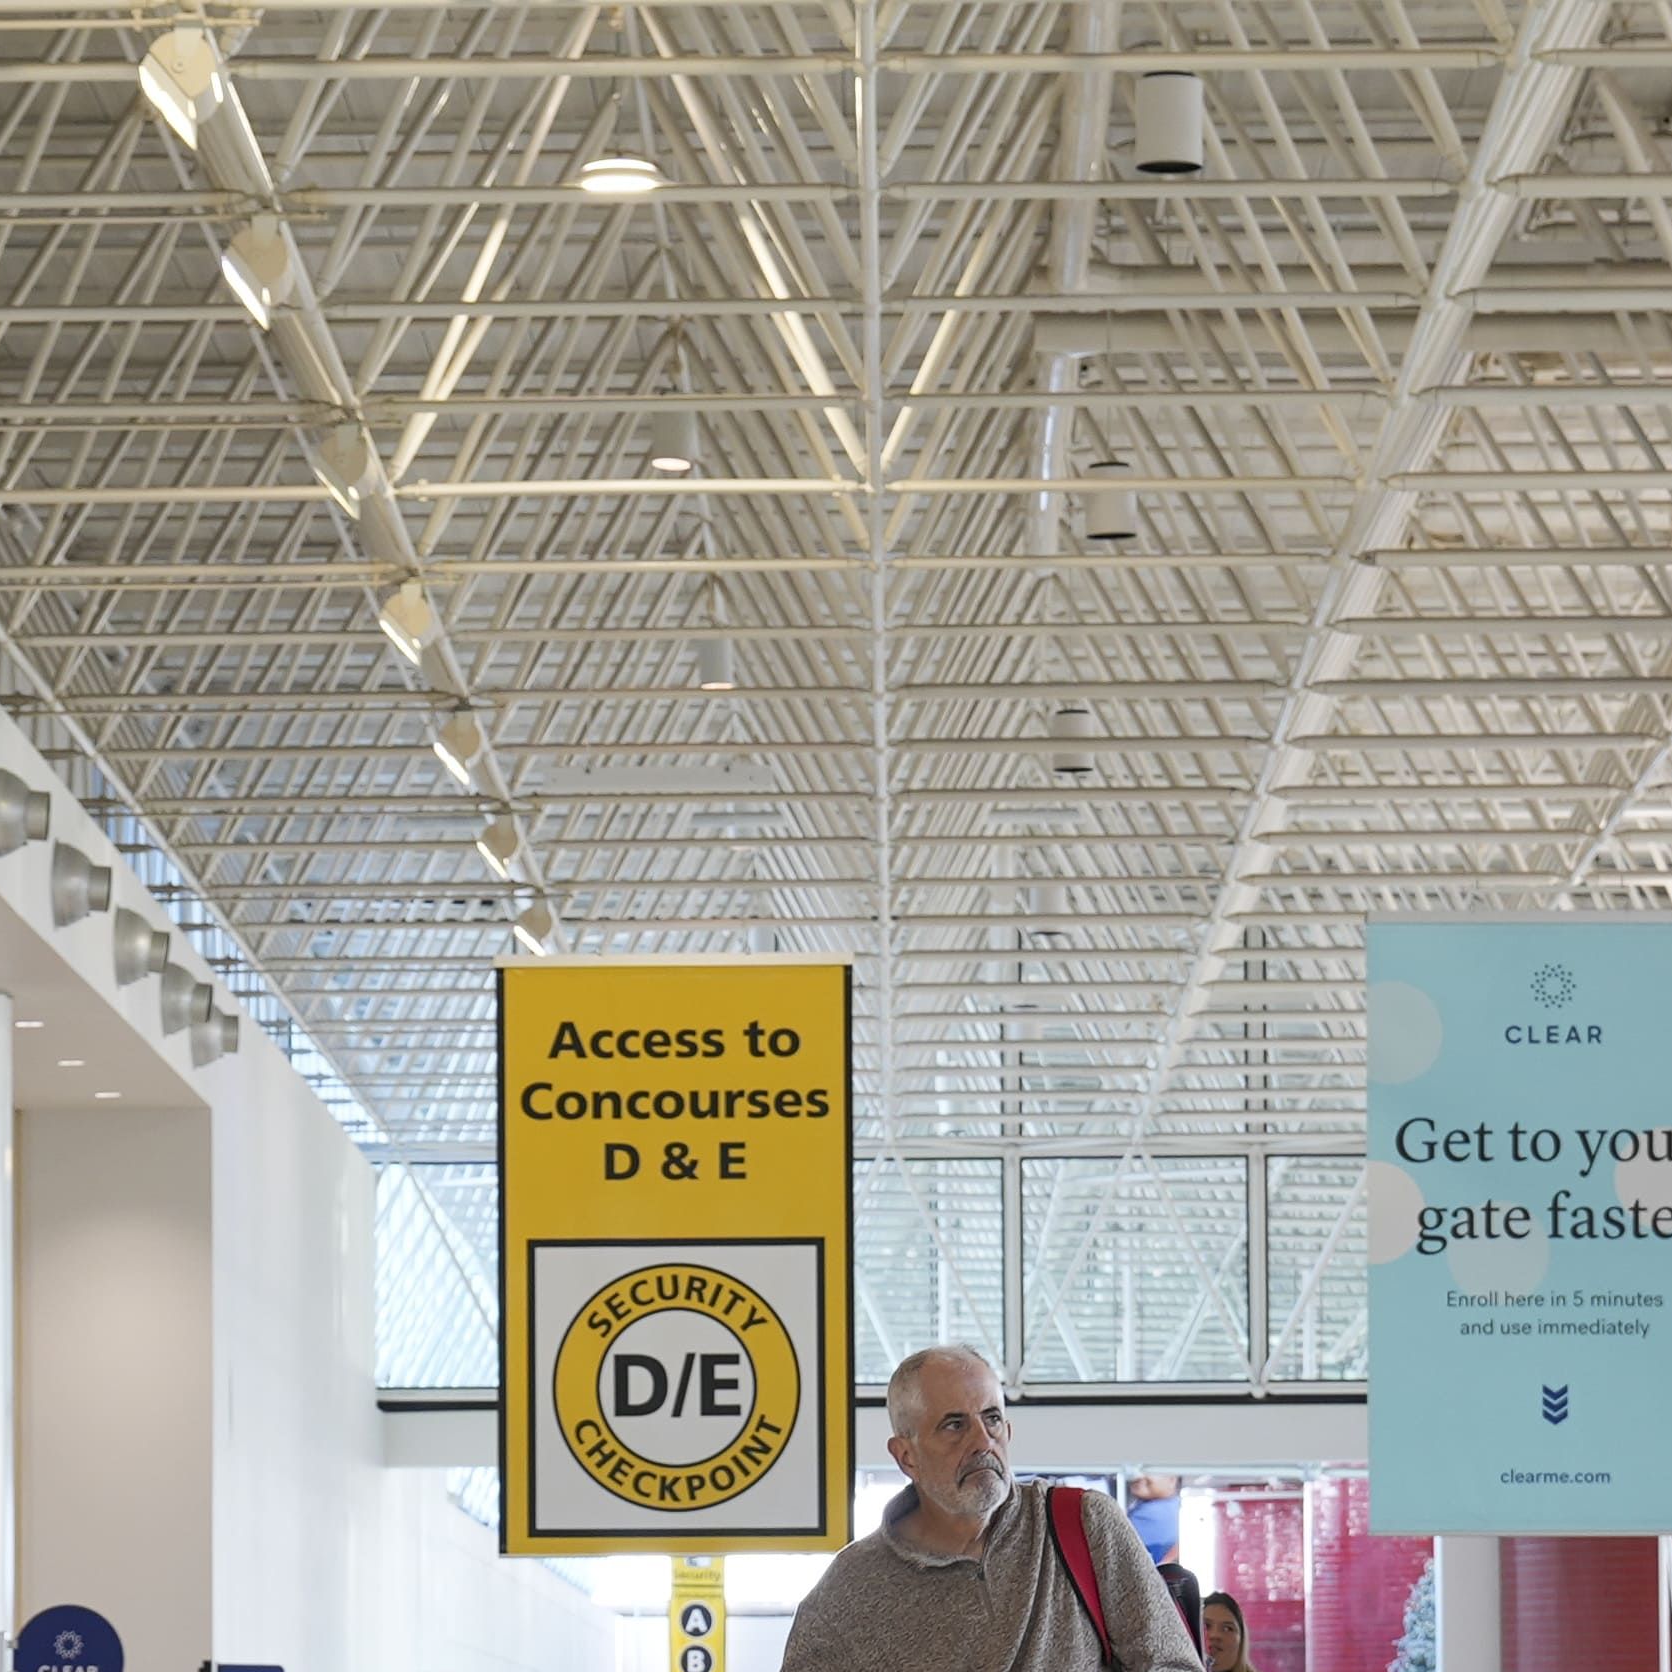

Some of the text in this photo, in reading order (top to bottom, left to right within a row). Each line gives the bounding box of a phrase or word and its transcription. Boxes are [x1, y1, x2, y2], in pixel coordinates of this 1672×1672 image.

[548, 1020, 800, 1059] Access to
[1504, 1024, 1604, 1045] CLEAR
[520, 1082, 830, 1120] Concourses
[1395, 1117, 1494, 1164] Get
[1510, 1120, 1561, 1164] to
[604, 1142, 748, 1180] D & E
[1415, 1198, 1531, 1256] gate
[586, 1275, 770, 1338] SECURITY
[1446, 1290, 1663, 1308] Enroll here in 5 minutes
[1459, 1318, 1651, 1340] and use immediately
[612, 1352, 742, 1418] D/E
[573, 1415, 783, 1503] CHECKPOINT
[1500, 1468, 1612, 1485] clearme.com
[685, 1607, 709, 1633] A
